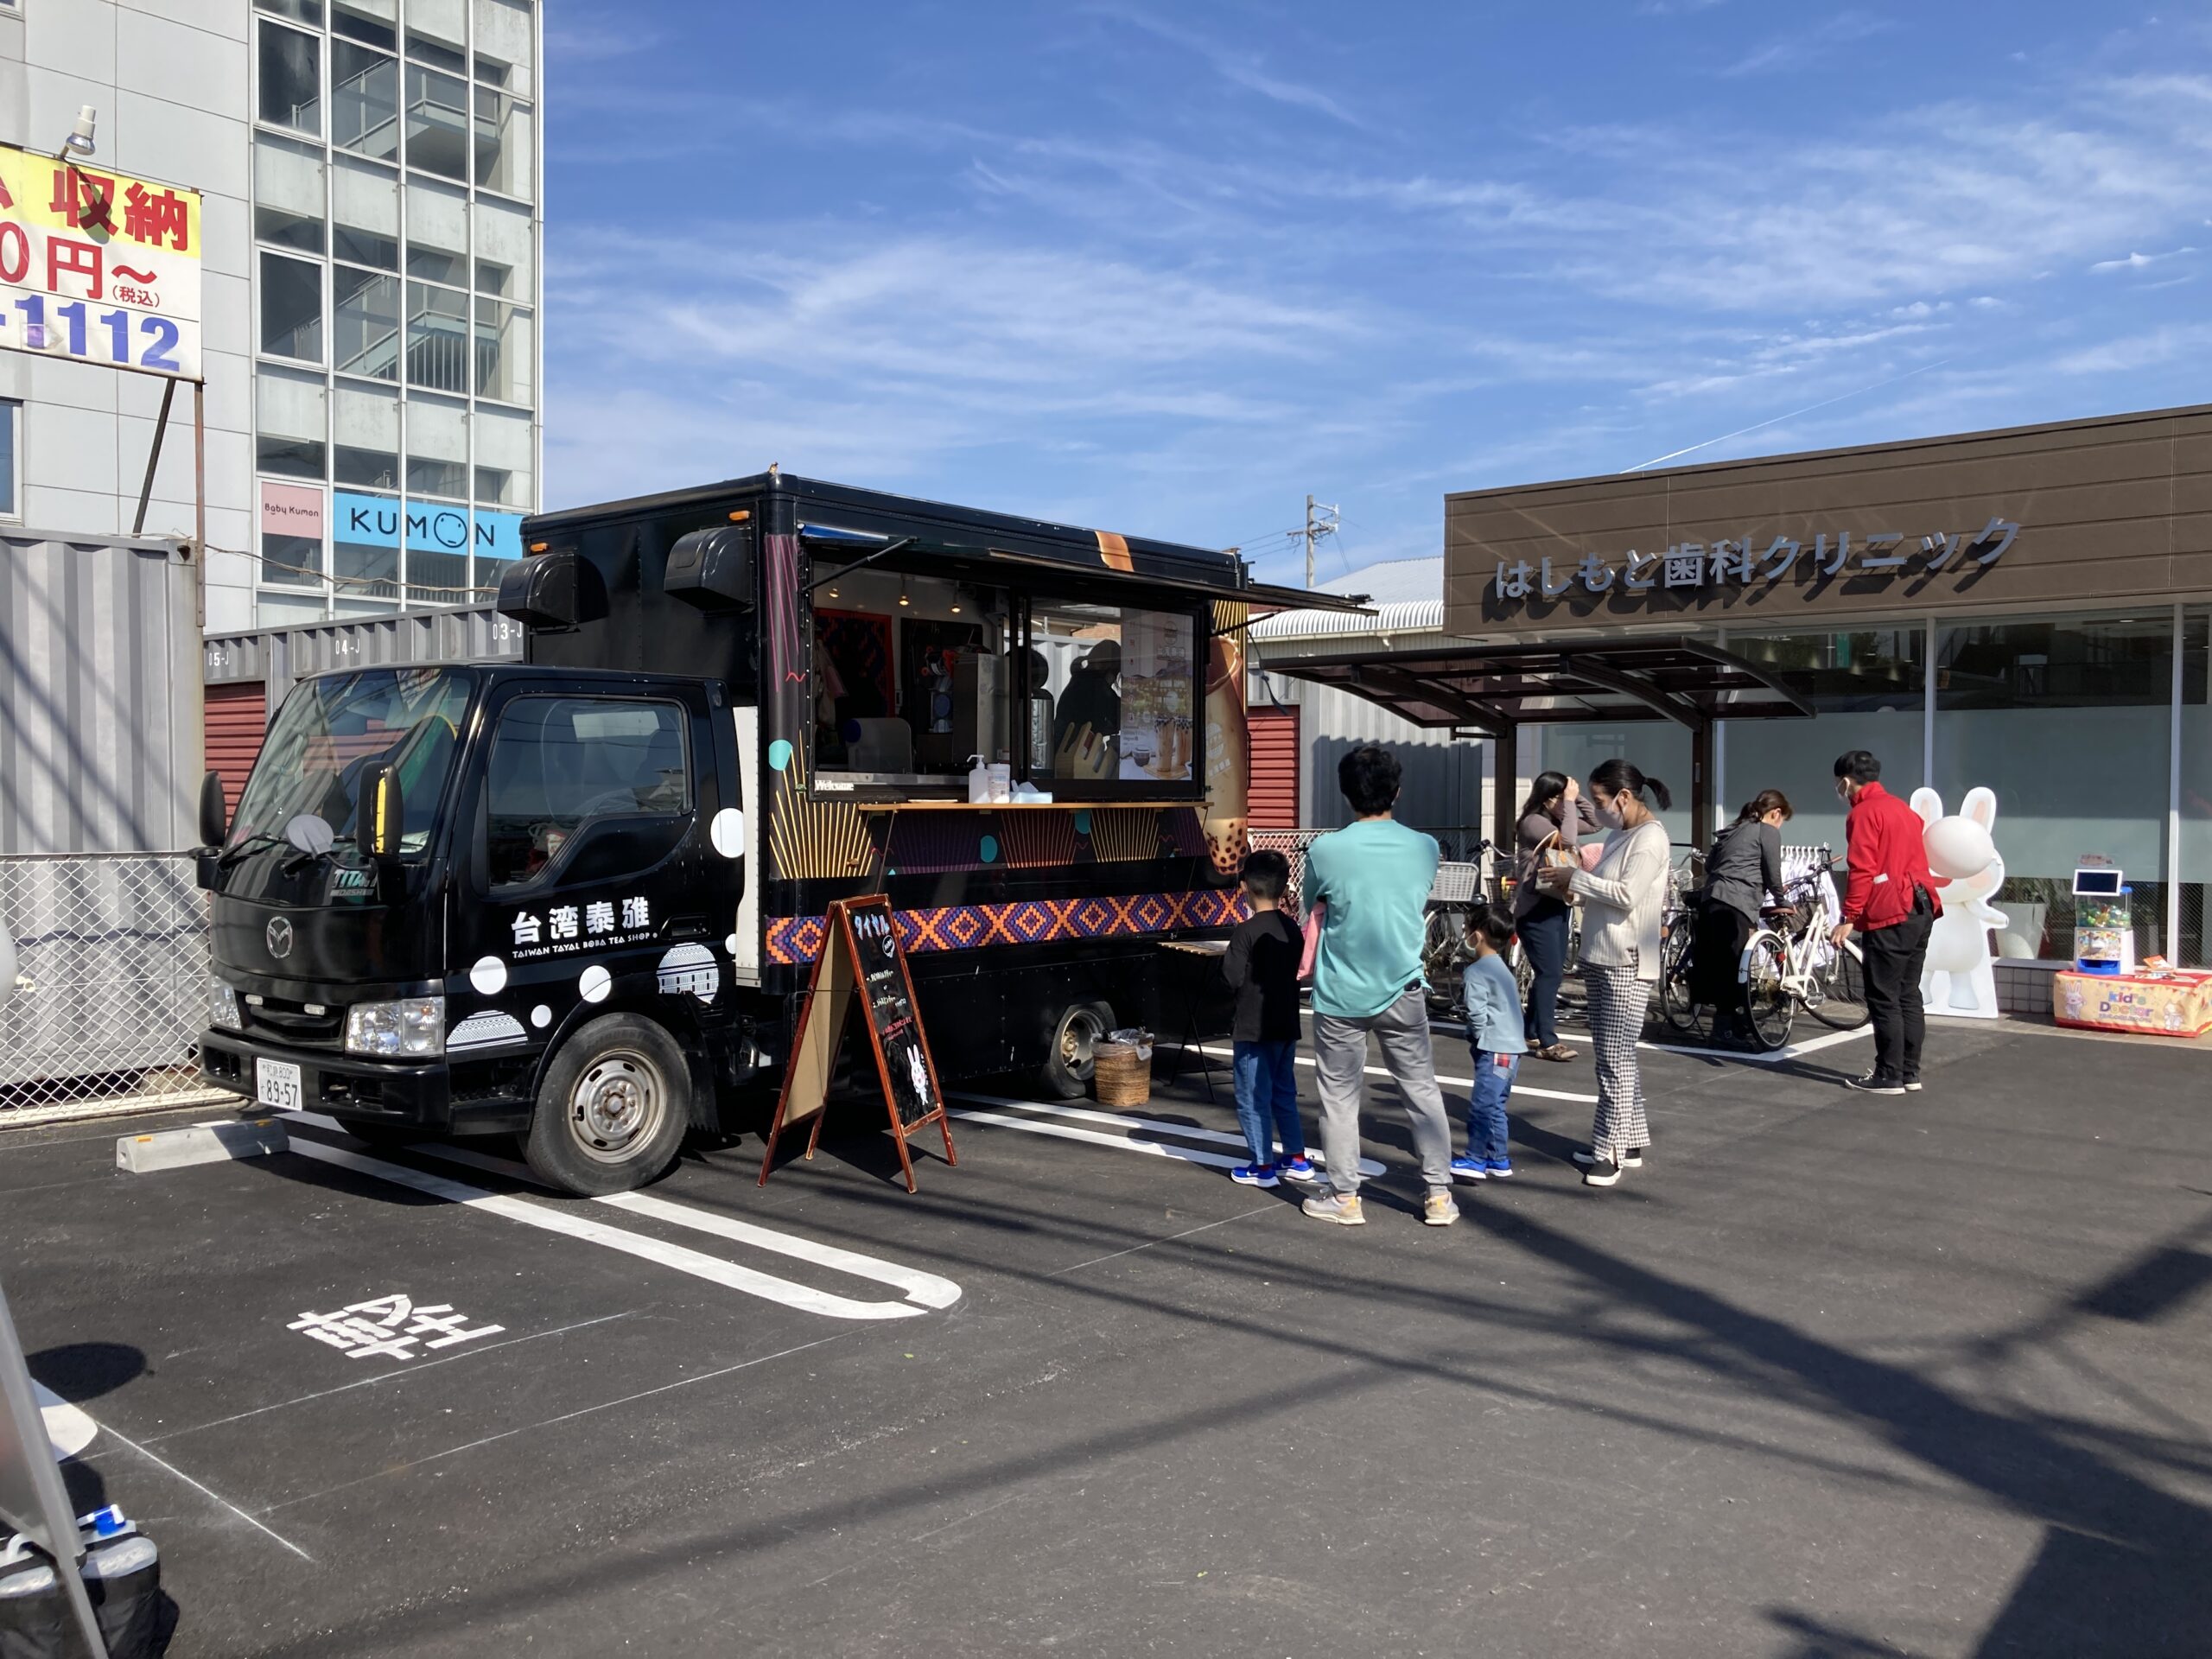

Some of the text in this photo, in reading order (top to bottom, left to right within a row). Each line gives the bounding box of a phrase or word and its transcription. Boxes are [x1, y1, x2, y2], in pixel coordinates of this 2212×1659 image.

[49, 166, 188, 251] 収納
[264, 502, 319, 517] Baby Kumon
[350, 507, 495, 548] KUMON
[1496, 518, 2019, 599] はしもと歯科クリニック
[493, 621, 522, 640] 03-J
[335, 638, 360, 655] 04-J
[511, 896, 650, 944] 台湾泰雅
[512, 932, 651, 959] TAIWAN TAYAL BOBA TEA SHOP
[266, 1078, 298, 1108] 89-57
